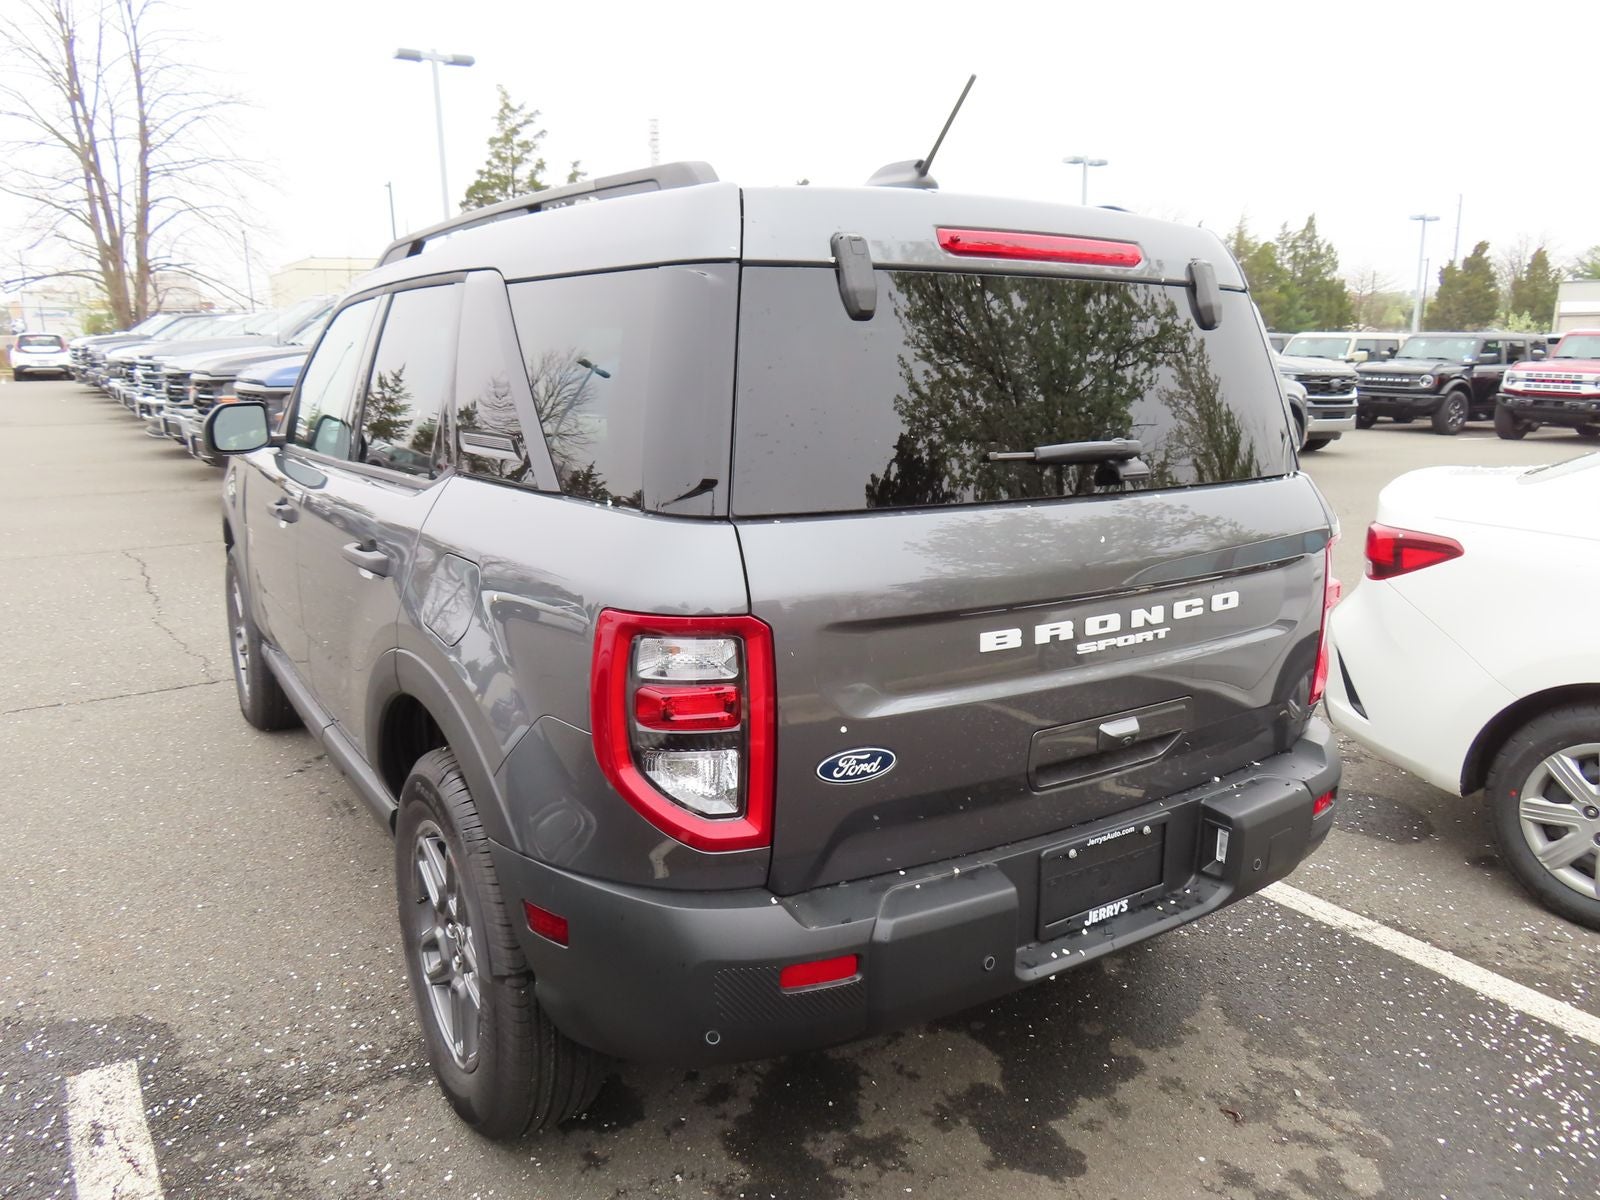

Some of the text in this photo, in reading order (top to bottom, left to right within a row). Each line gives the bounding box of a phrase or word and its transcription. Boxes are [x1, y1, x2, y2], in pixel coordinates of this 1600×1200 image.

[979, 590, 1240, 653] BRONCO
[1076, 627, 1171, 655] SPORT
[832, 753, 882, 778] Ford
[1086, 826, 1135, 847] JerrysAuto.com
[1084, 899, 1128, 926] JERRY'S
